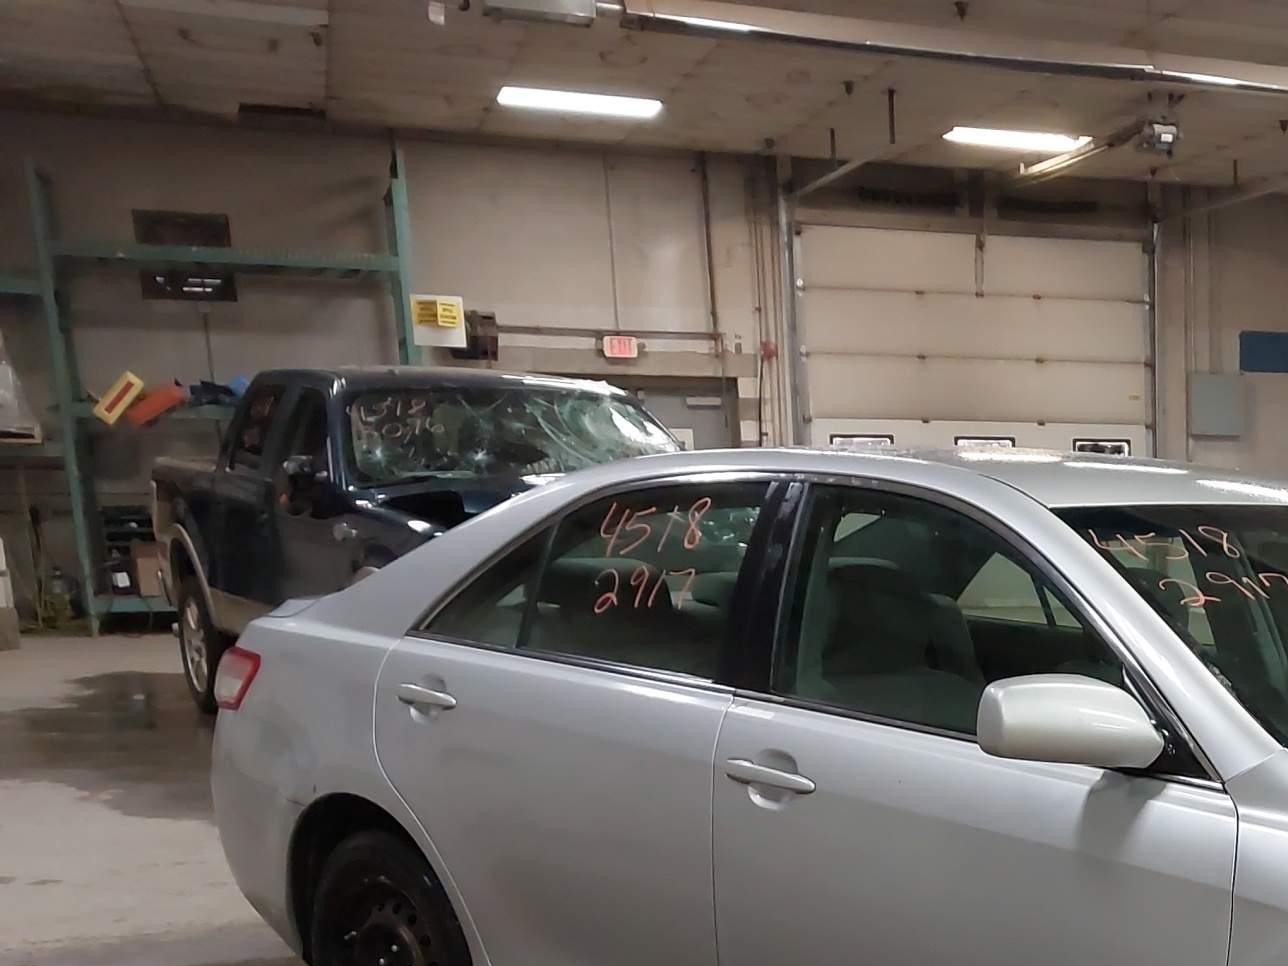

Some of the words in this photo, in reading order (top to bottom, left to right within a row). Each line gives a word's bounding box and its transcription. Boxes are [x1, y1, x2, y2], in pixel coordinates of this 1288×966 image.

[610, 337, 633, 355] EXIT
[600, 497, 711, 557] 4518
[1088, 526, 1240, 560] 4518
[594, 565, 695, 614] 2917
